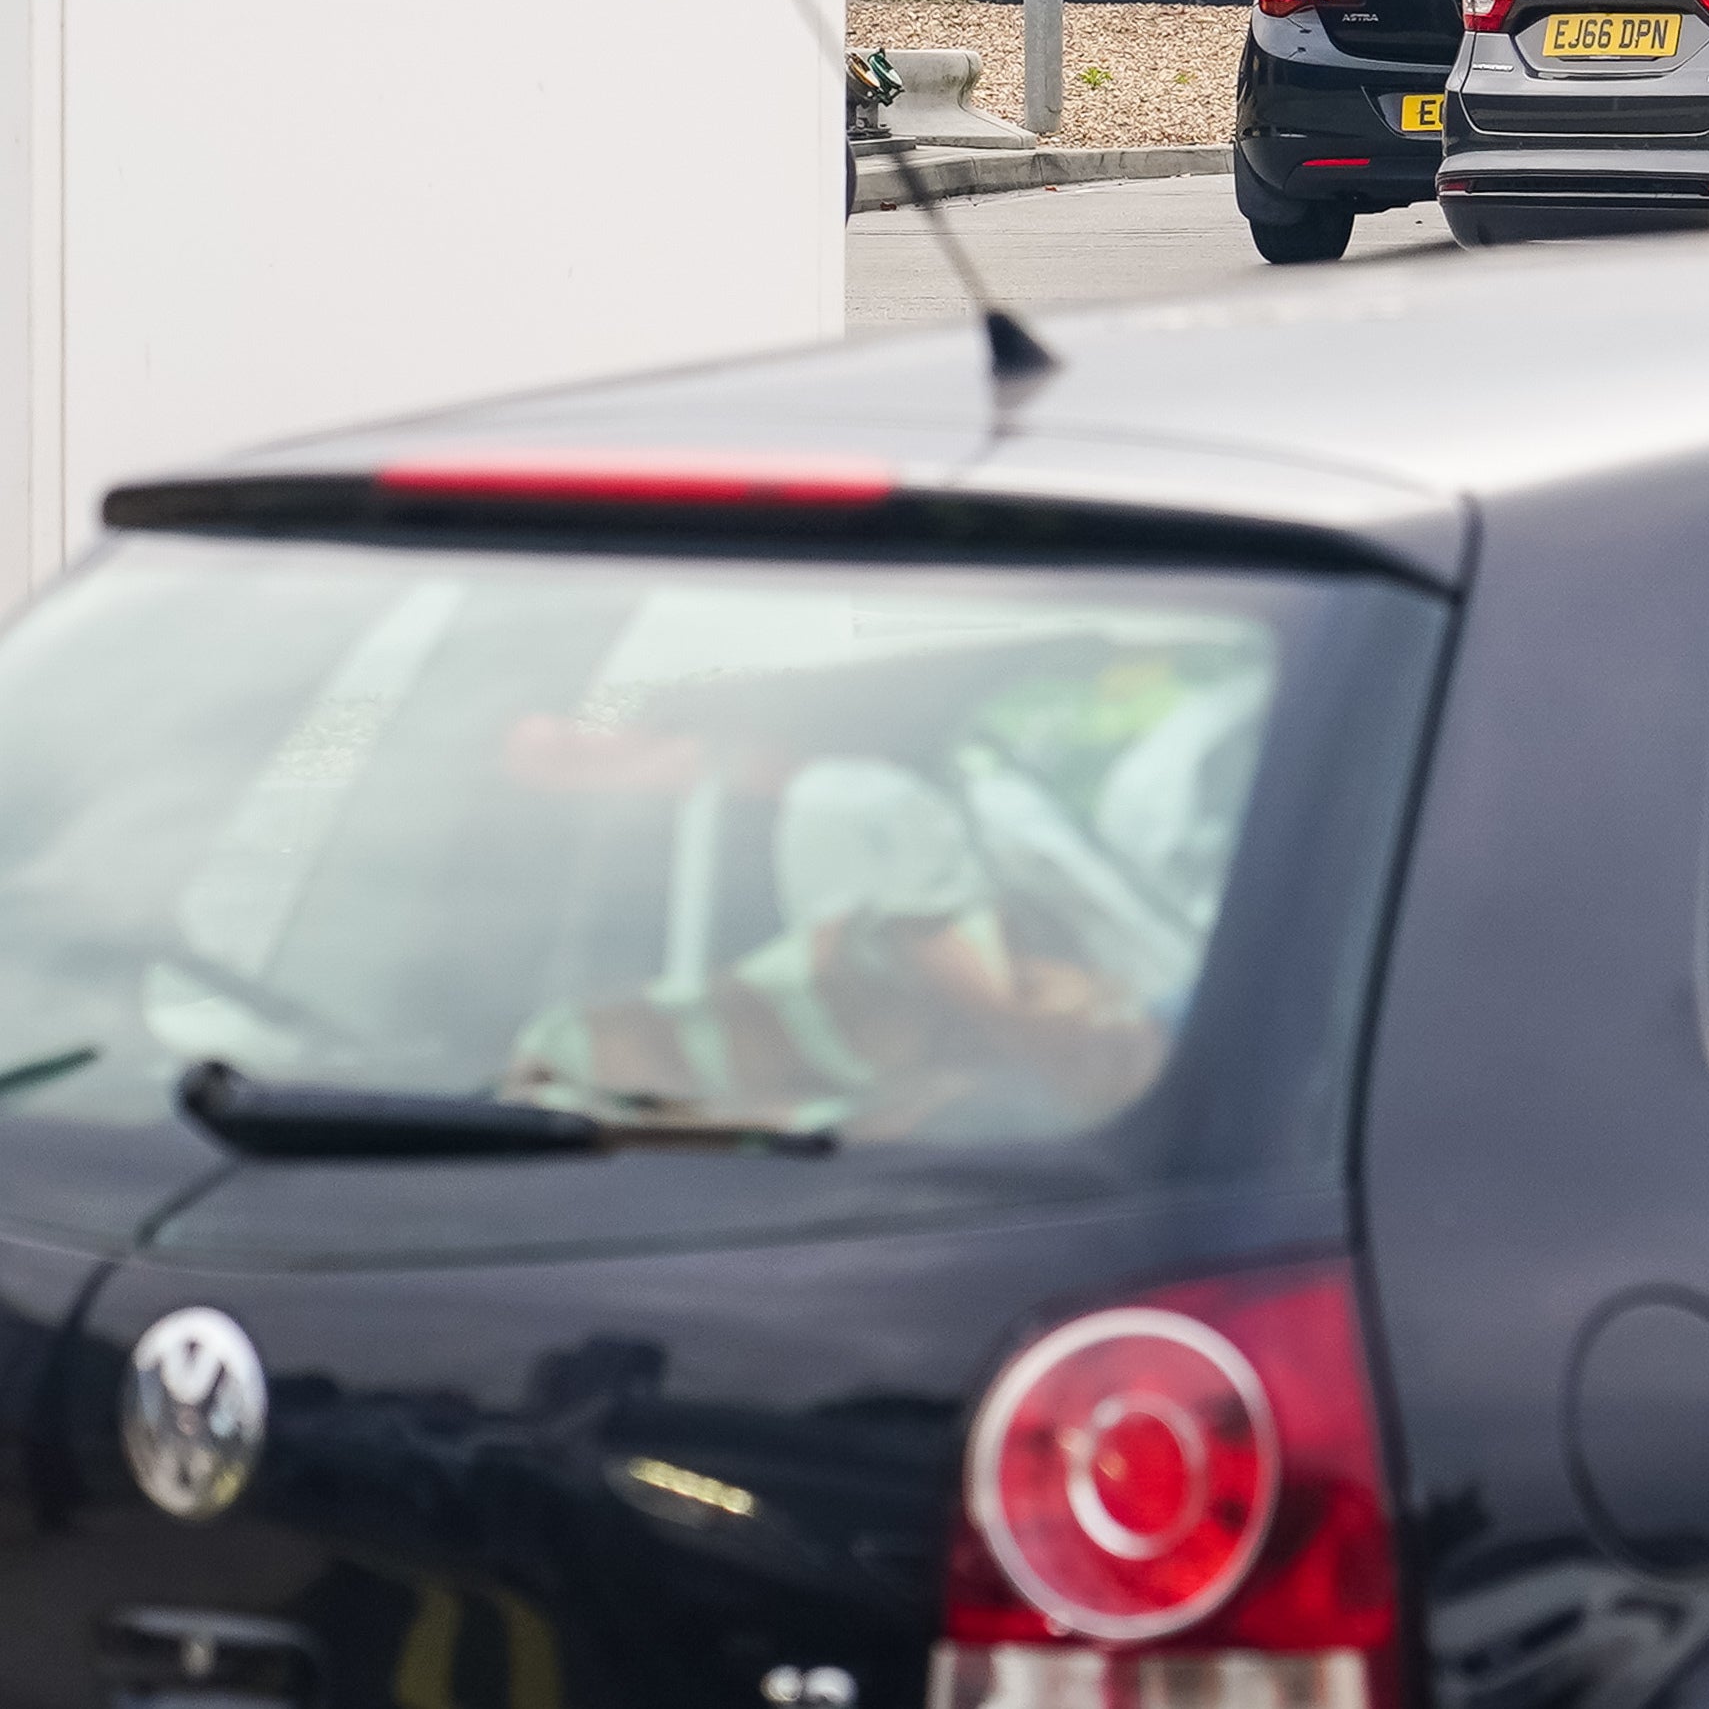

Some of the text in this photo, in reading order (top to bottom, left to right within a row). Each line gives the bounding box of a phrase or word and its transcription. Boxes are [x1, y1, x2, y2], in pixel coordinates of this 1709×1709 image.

[1342, 12, 1379, 22] ASTRA
[1553, 18, 1669, 50] EJ66 DPN
